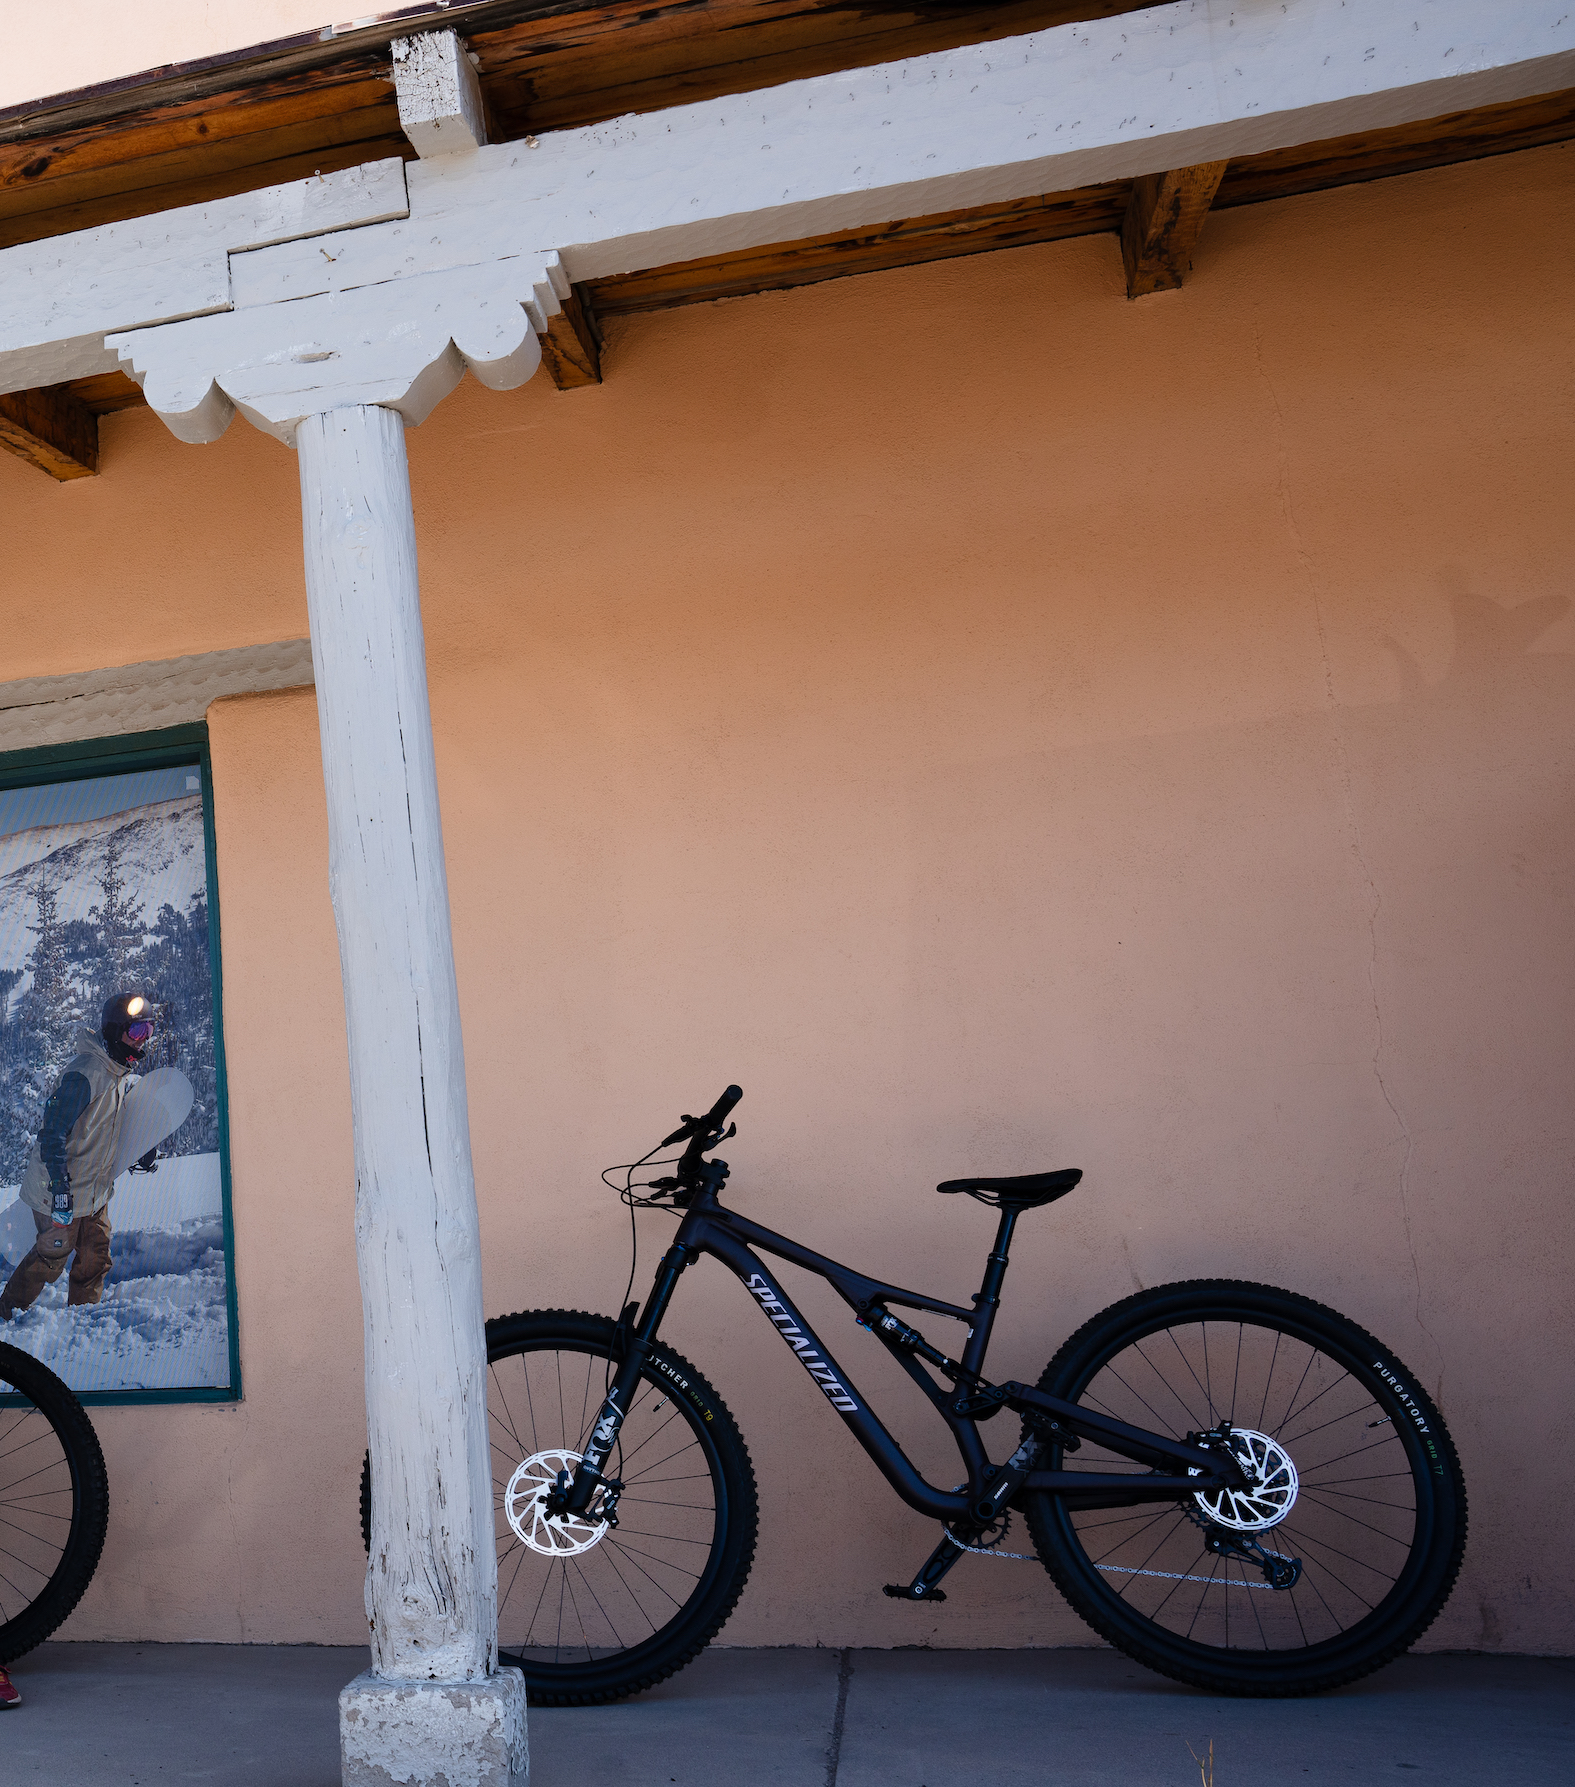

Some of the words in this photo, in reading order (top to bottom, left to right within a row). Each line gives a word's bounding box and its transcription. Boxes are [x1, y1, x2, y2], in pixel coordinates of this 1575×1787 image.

[647, 1354, 689, 1390] UTCHER
[739, 1272, 859, 1412] SPECIALIZED
[583, 1412, 620, 1466] FOX
[1372, 1361, 1430, 1435] PURGATORY
[1426, 1440, 1438, 1460] GRID
[1433, 1465, 1444, 1477] T7
